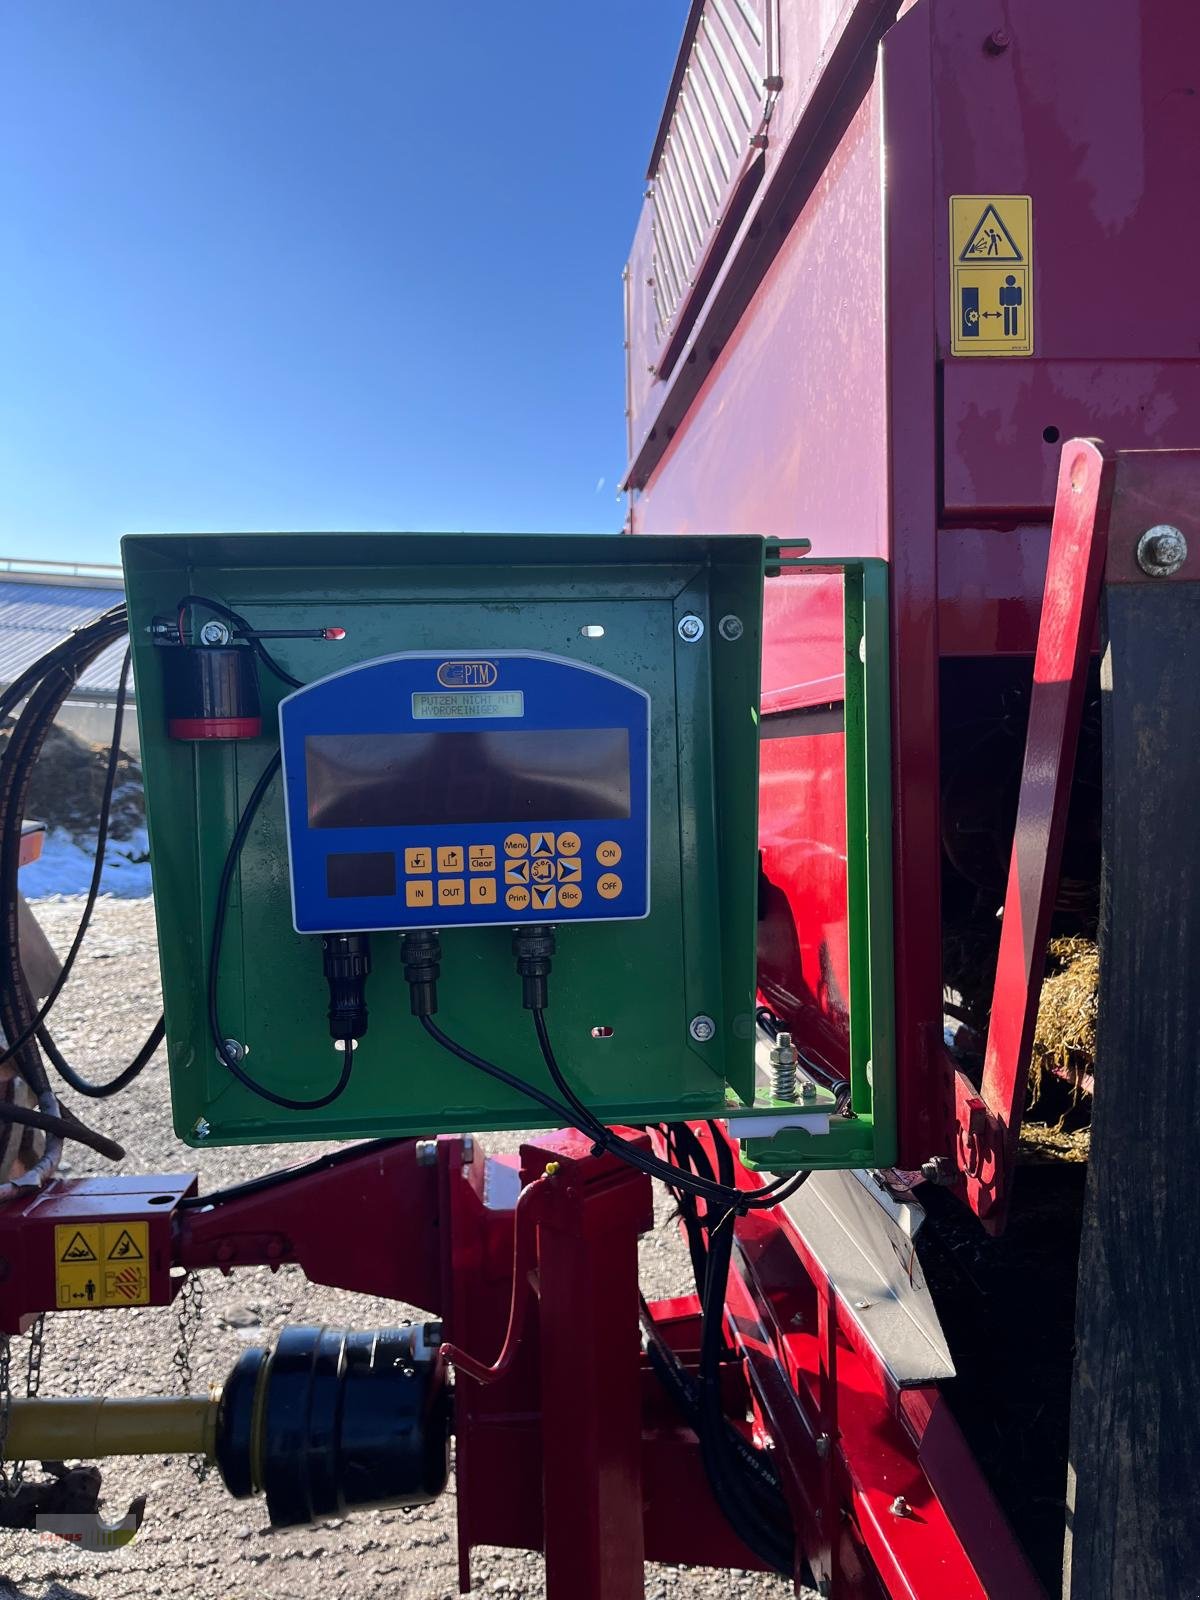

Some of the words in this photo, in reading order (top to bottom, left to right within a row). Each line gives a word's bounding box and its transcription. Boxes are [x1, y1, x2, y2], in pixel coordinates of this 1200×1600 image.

[465, 664, 489, 683] PTM
[420, 696, 457, 706] PUTZEN
[463, 695, 492, 705] NICHT
[498, 694, 516, 703] MIT
[420, 705, 498, 716] HYDROREINIGER
[505, 841, 527, 849] Menu
[562, 840, 575, 848] Esc
[478, 848, 484, 857] T
[602, 850, 615, 858] ON
[472, 859, 492, 868] Clear
[532, 860, 550, 877] Enter
[602, 882, 617, 890] OFF
[415, 890, 423, 898] IN
[442, 888, 459, 897] OUT
[562, 892, 579, 900] Bloc
[508, 894, 527, 902] Print
